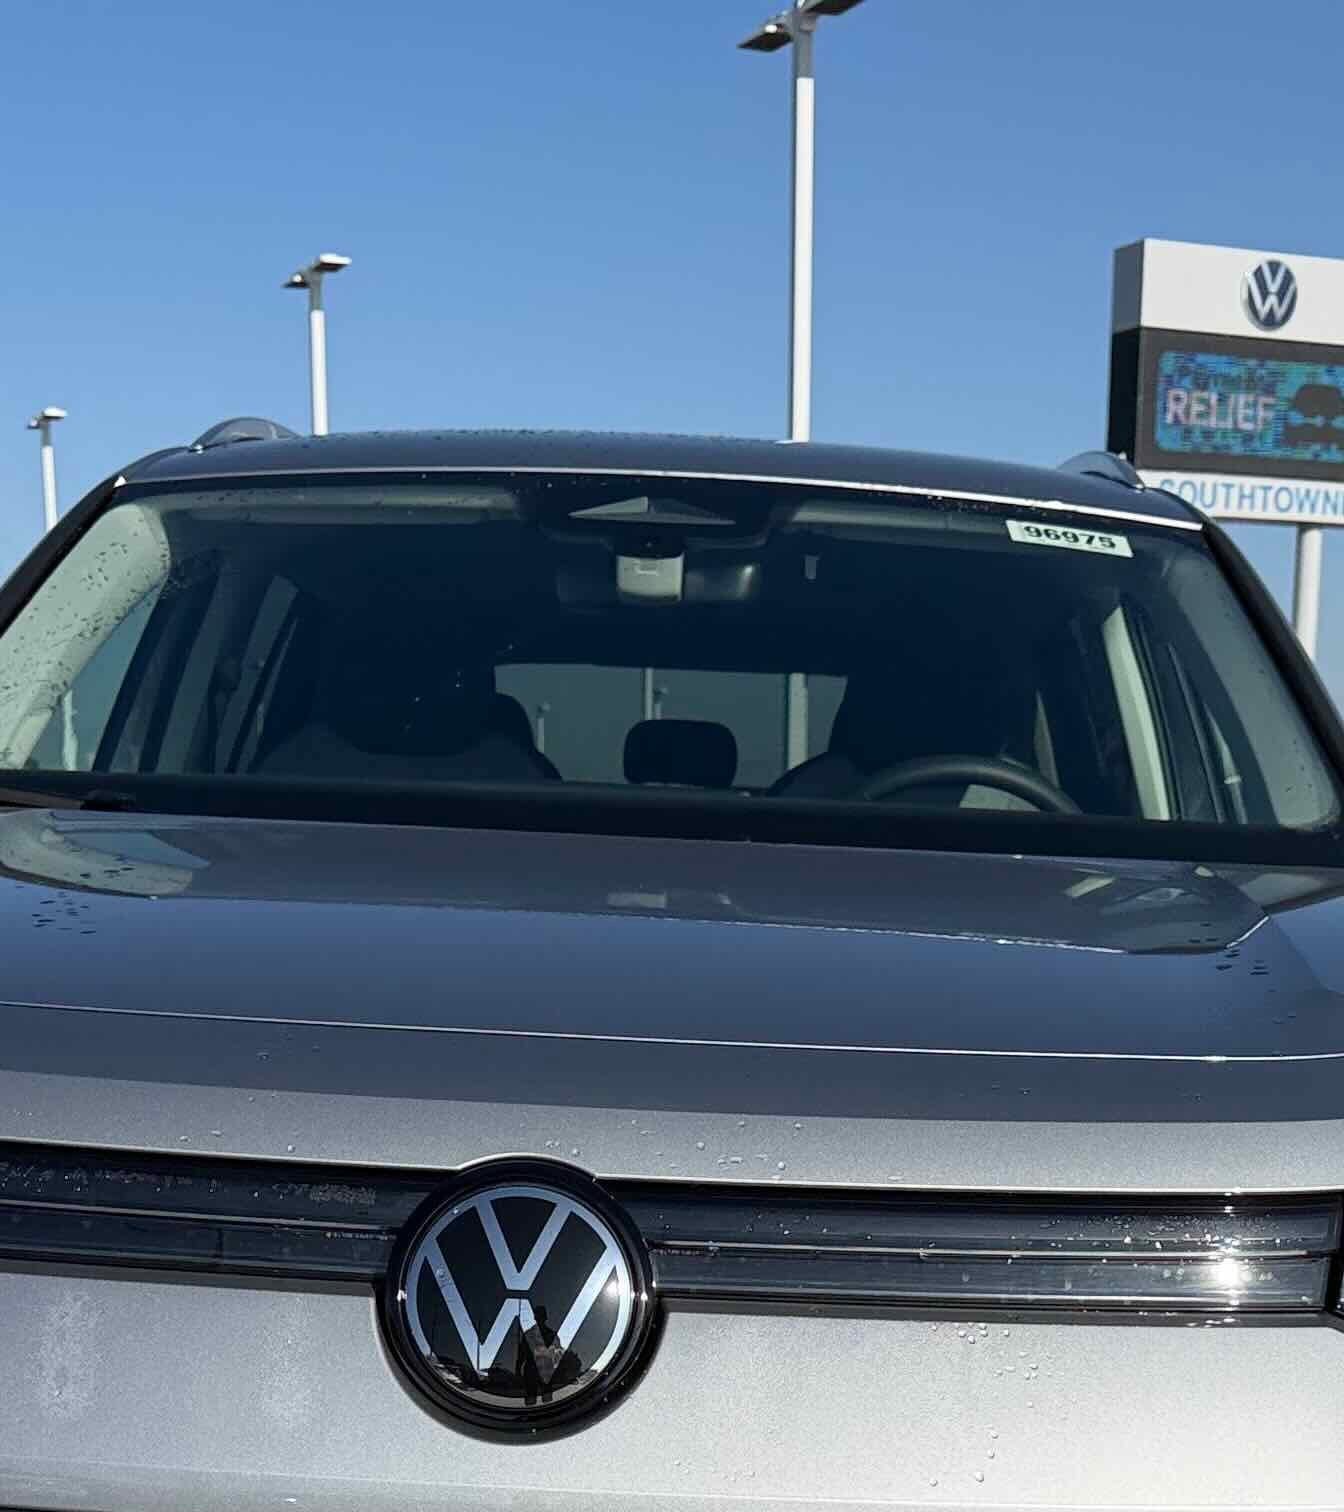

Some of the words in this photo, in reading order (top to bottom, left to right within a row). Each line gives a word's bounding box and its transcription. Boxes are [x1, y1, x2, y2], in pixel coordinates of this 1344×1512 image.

[1246, 260, 1297, 328] VW
[1165, 388, 1277, 430] RELIEF
[1023, 525, 1116, 548] 96975
[406, 1186, 632, 1408] VW
